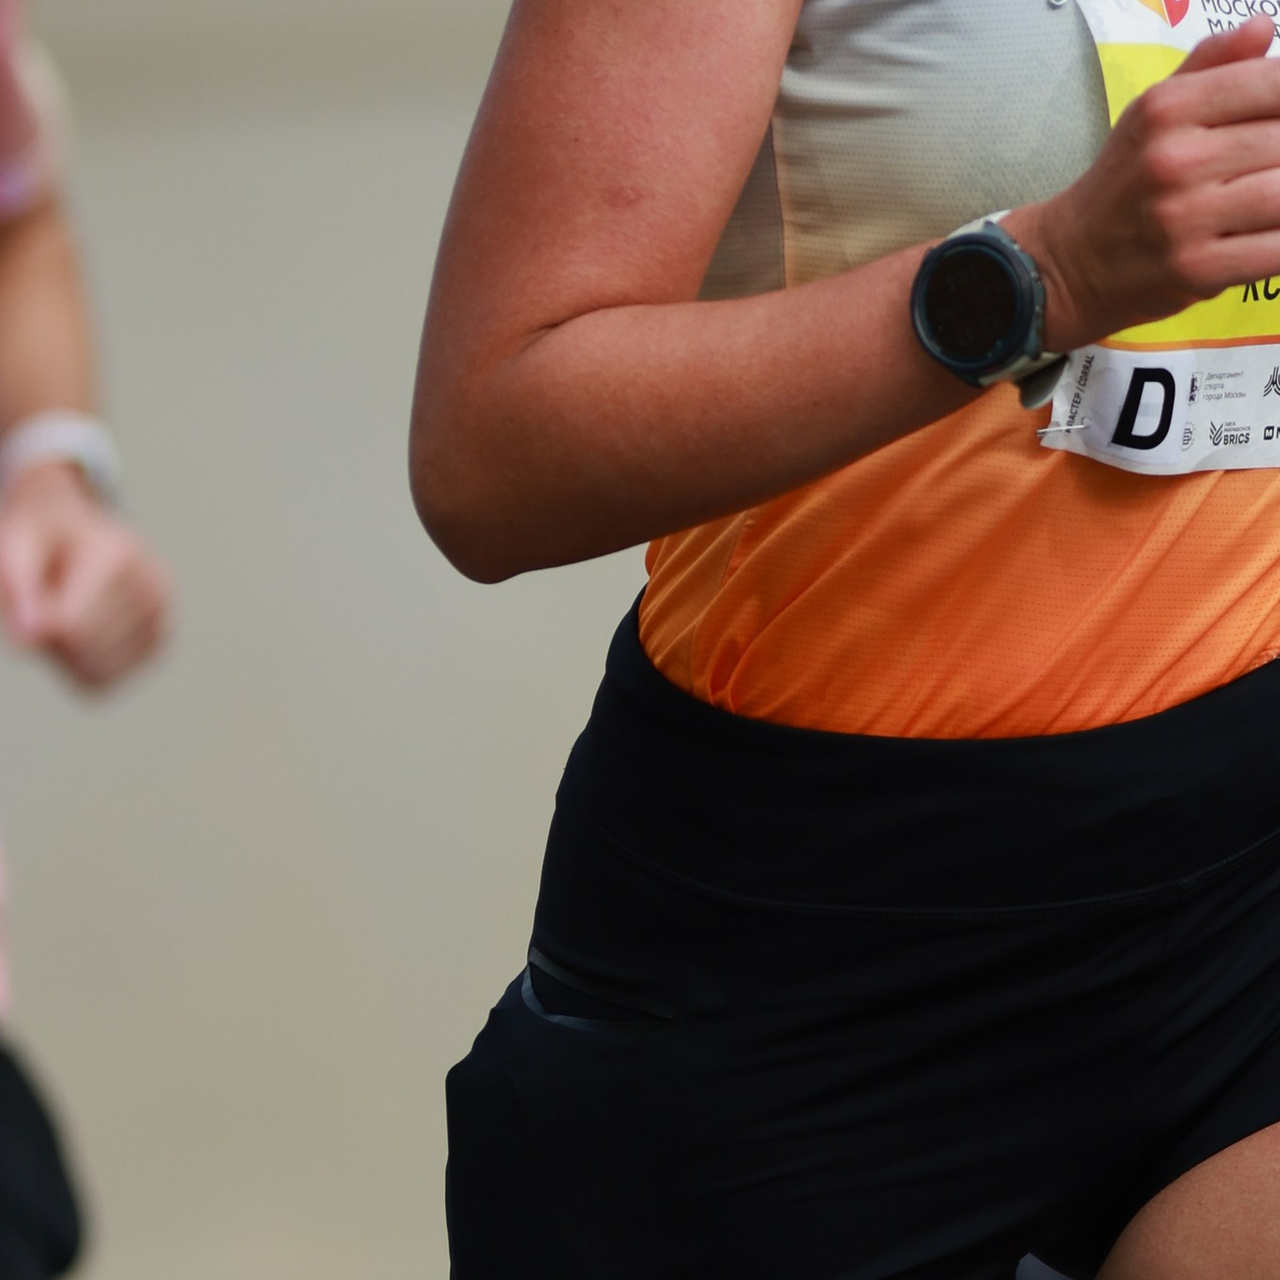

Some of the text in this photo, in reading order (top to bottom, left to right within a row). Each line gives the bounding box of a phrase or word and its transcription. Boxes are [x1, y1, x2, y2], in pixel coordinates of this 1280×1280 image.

[1078, 355, 1095, 388] CORRAL
[1110, 366, 1176, 450] D
[1223, 433, 1250, 445] BRICS
